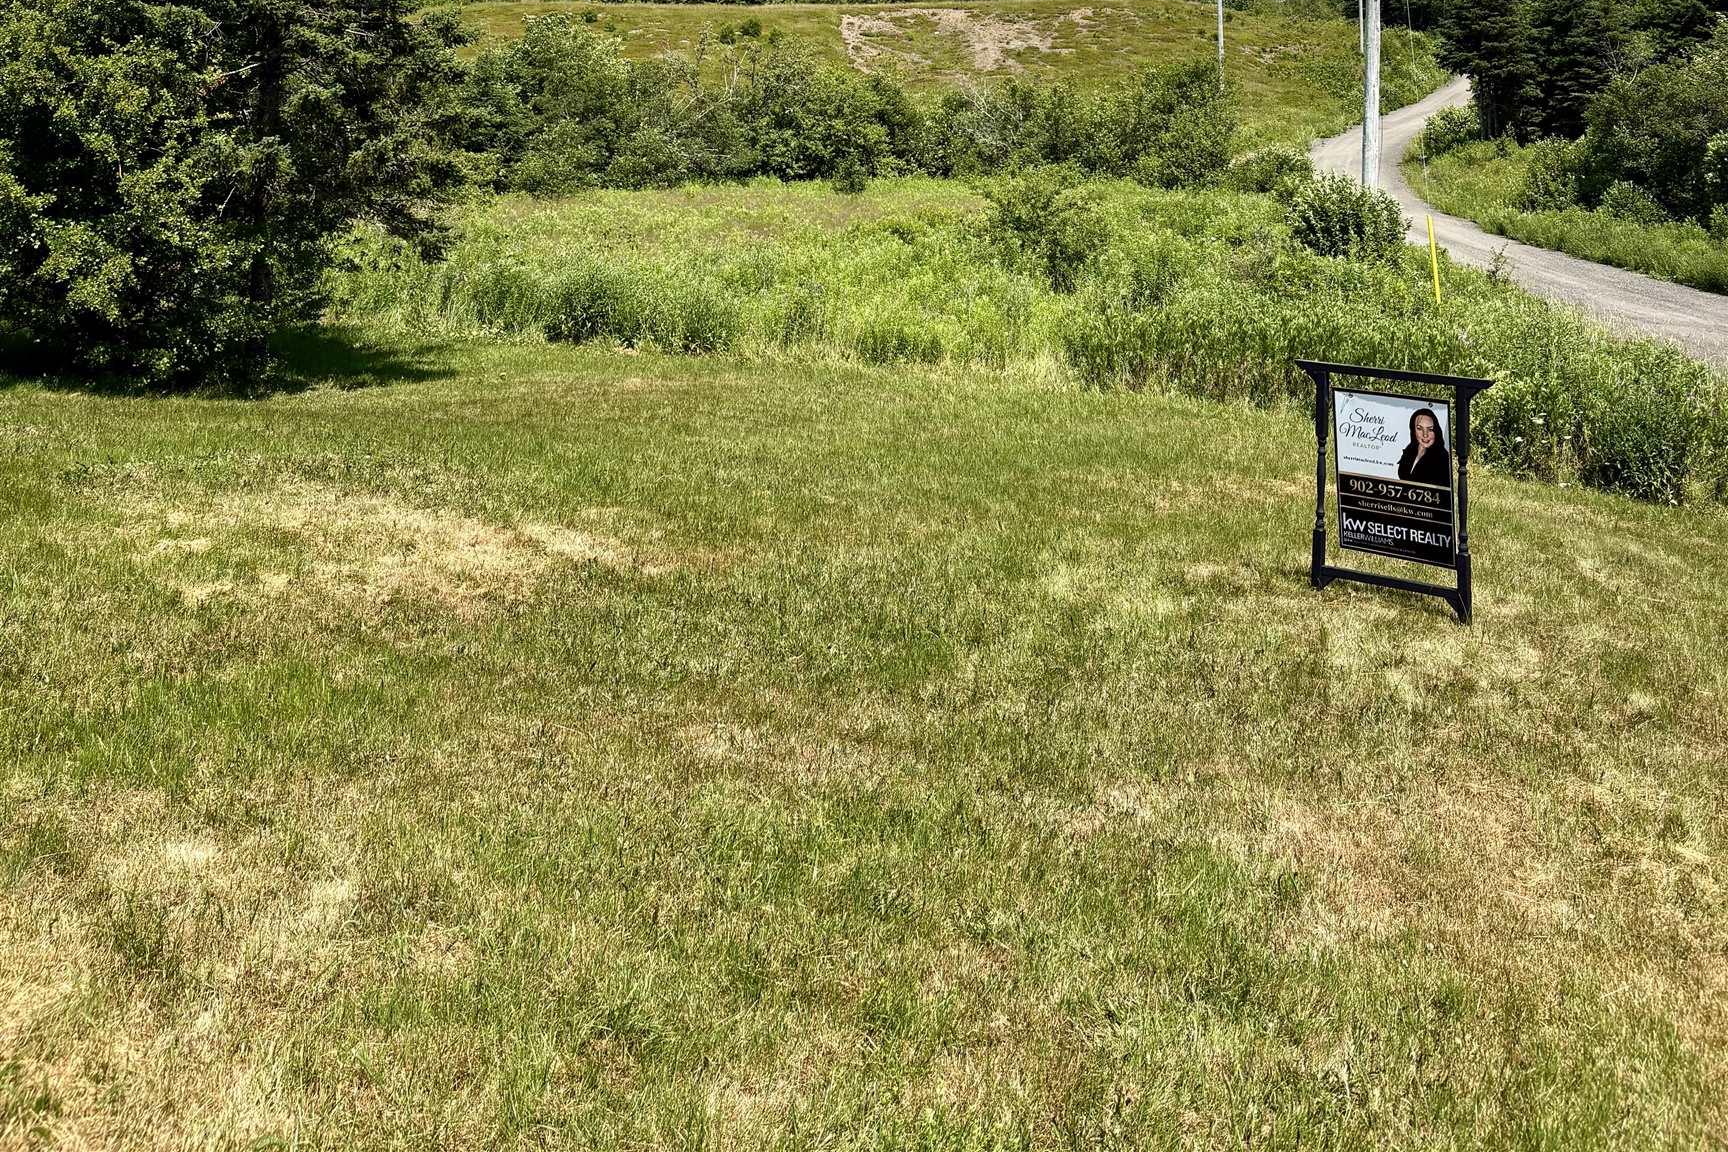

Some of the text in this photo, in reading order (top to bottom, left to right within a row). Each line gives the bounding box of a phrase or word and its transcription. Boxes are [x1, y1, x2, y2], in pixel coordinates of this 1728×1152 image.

[1349, 407, 1385, 425] Sherri
[1349, 478, 1441, 504] 902-957-6784
[1367, 521, 1409, 541] SELECT
[1409, 529, 1452, 549] REALTY
